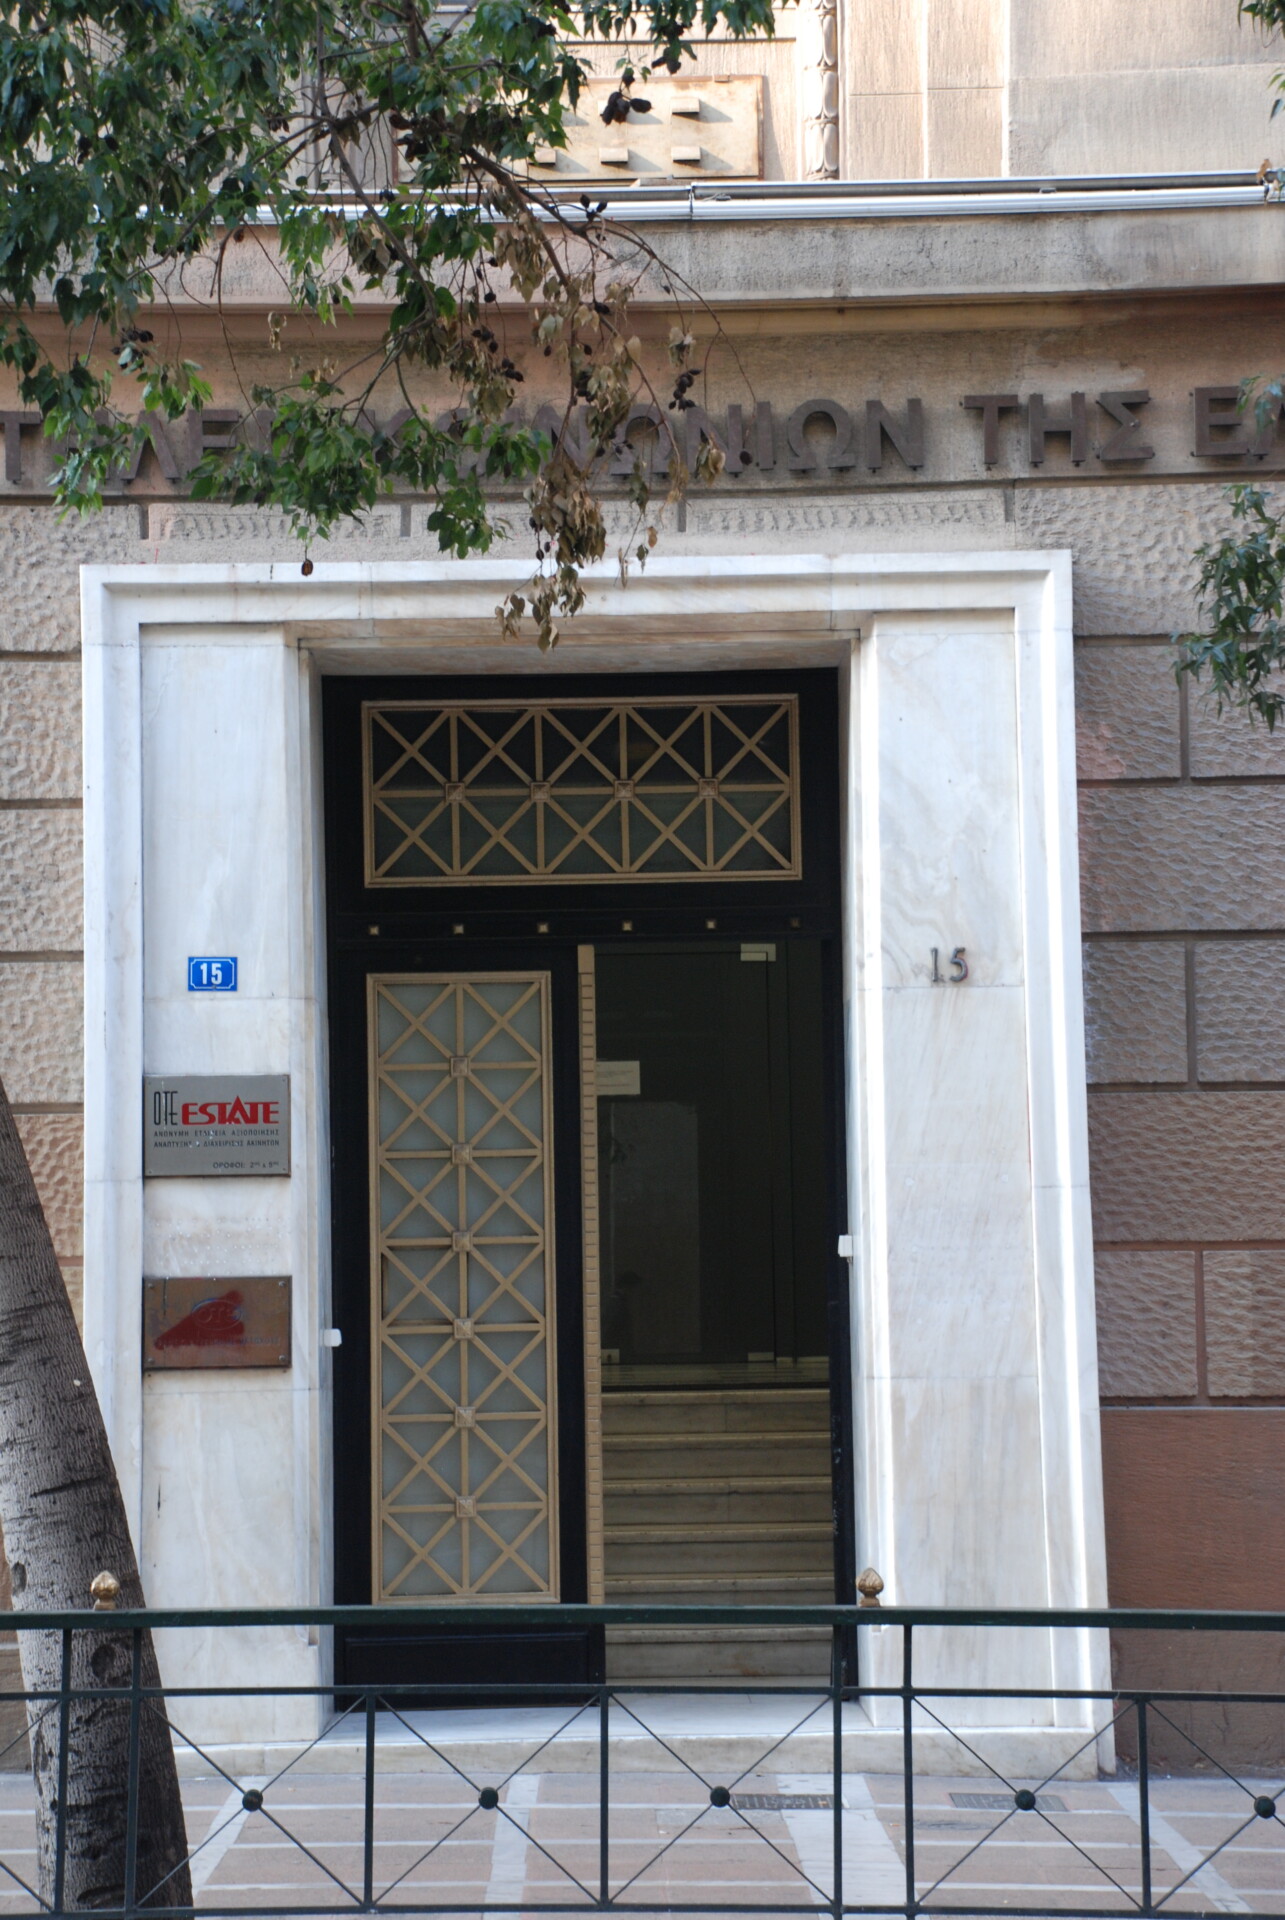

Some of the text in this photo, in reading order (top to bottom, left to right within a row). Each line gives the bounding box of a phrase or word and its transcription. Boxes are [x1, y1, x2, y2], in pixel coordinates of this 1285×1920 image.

[963, 390, 1154, 466] ΤΗΣ
[1194, 385, 1285, 457] Ε
[200, 962, 223, 985] 15
[930, 947, 969, 983] 15
[181, 1094, 279, 1126] ESTATE
